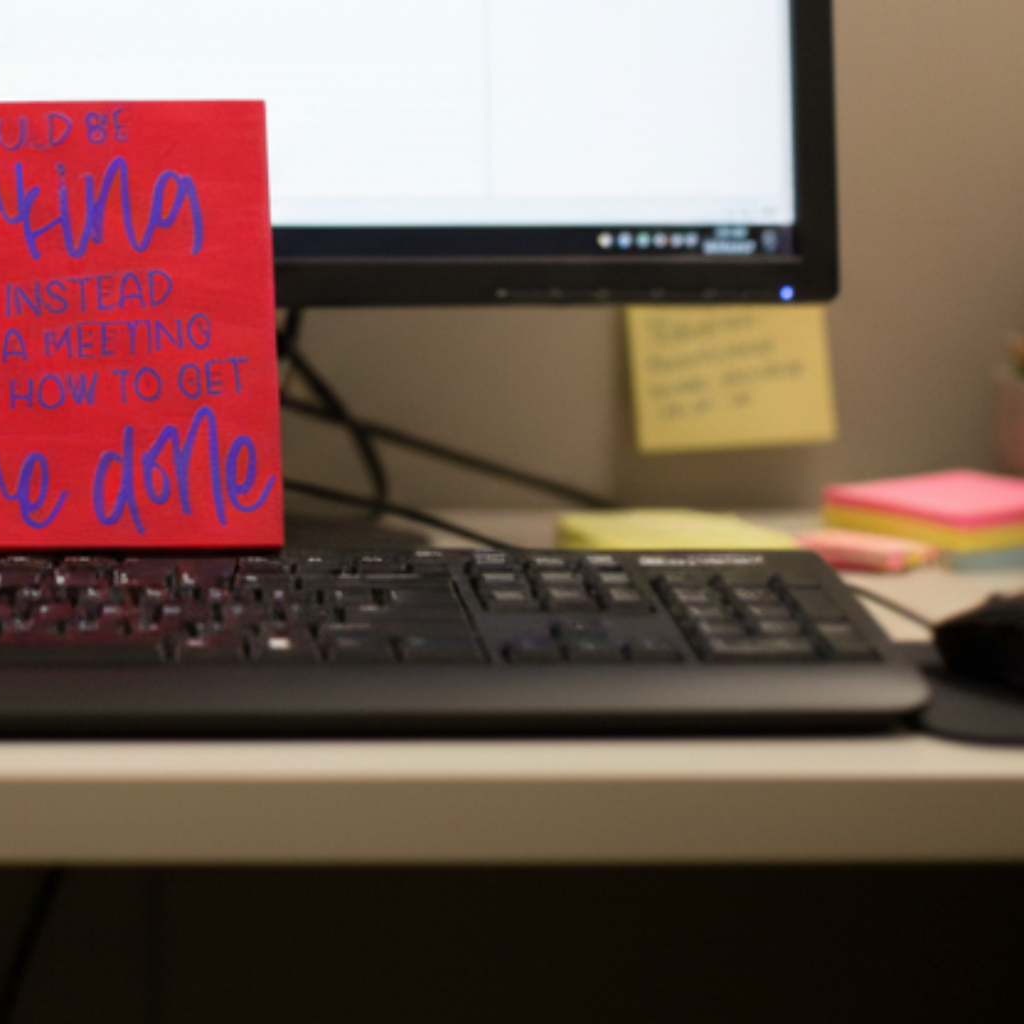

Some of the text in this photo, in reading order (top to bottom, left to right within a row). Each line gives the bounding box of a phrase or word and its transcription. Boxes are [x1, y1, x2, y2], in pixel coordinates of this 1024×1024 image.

[85, 108, 130, 145] BE
[6, 270, 173, 317] INSTEAD
[2, 328, 27, 363] A
[44, 313, 212, 359] MEETING
[9, 372, 99, 409] HOW
[112, 366, 162, 403] TO
[178, 357, 249, 400] GET
